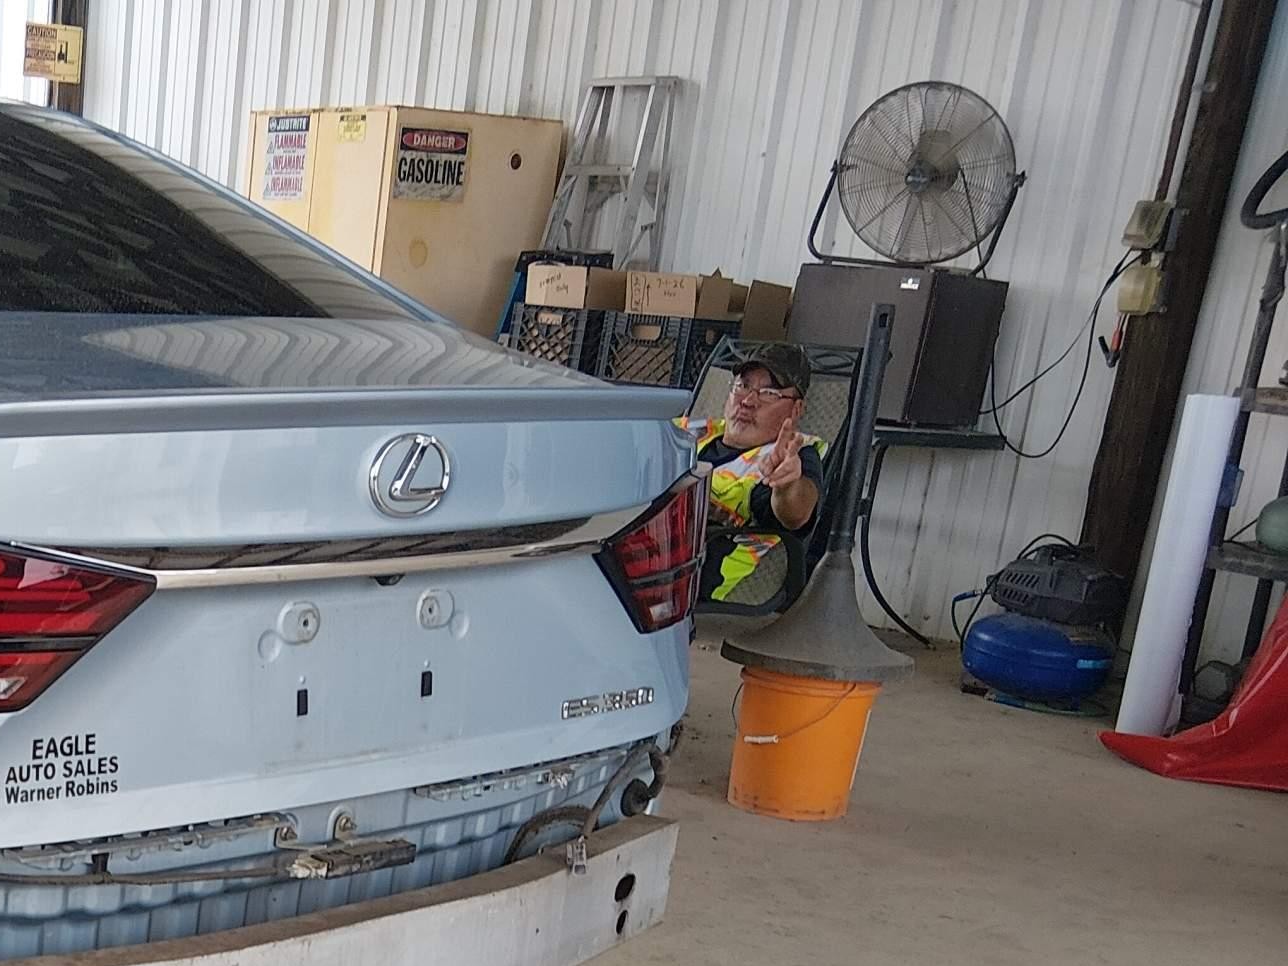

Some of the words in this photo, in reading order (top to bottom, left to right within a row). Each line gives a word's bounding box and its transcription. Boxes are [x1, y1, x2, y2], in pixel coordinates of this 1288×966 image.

[27, 26, 57, 38] CAUTION
[273, 133, 307, 150] FLAMMABLE
[413, 133, 456, 149] DANGER
[398, 157, 465, 185] GASOLINE
[32, 733, 97, 760] EAGLE
[5, 762, 56, 785] AUTO
[62, 756, 119, 778] SALES
[5, 785, 62, 804] Warner
[66, 777, 118, 798] Robins
